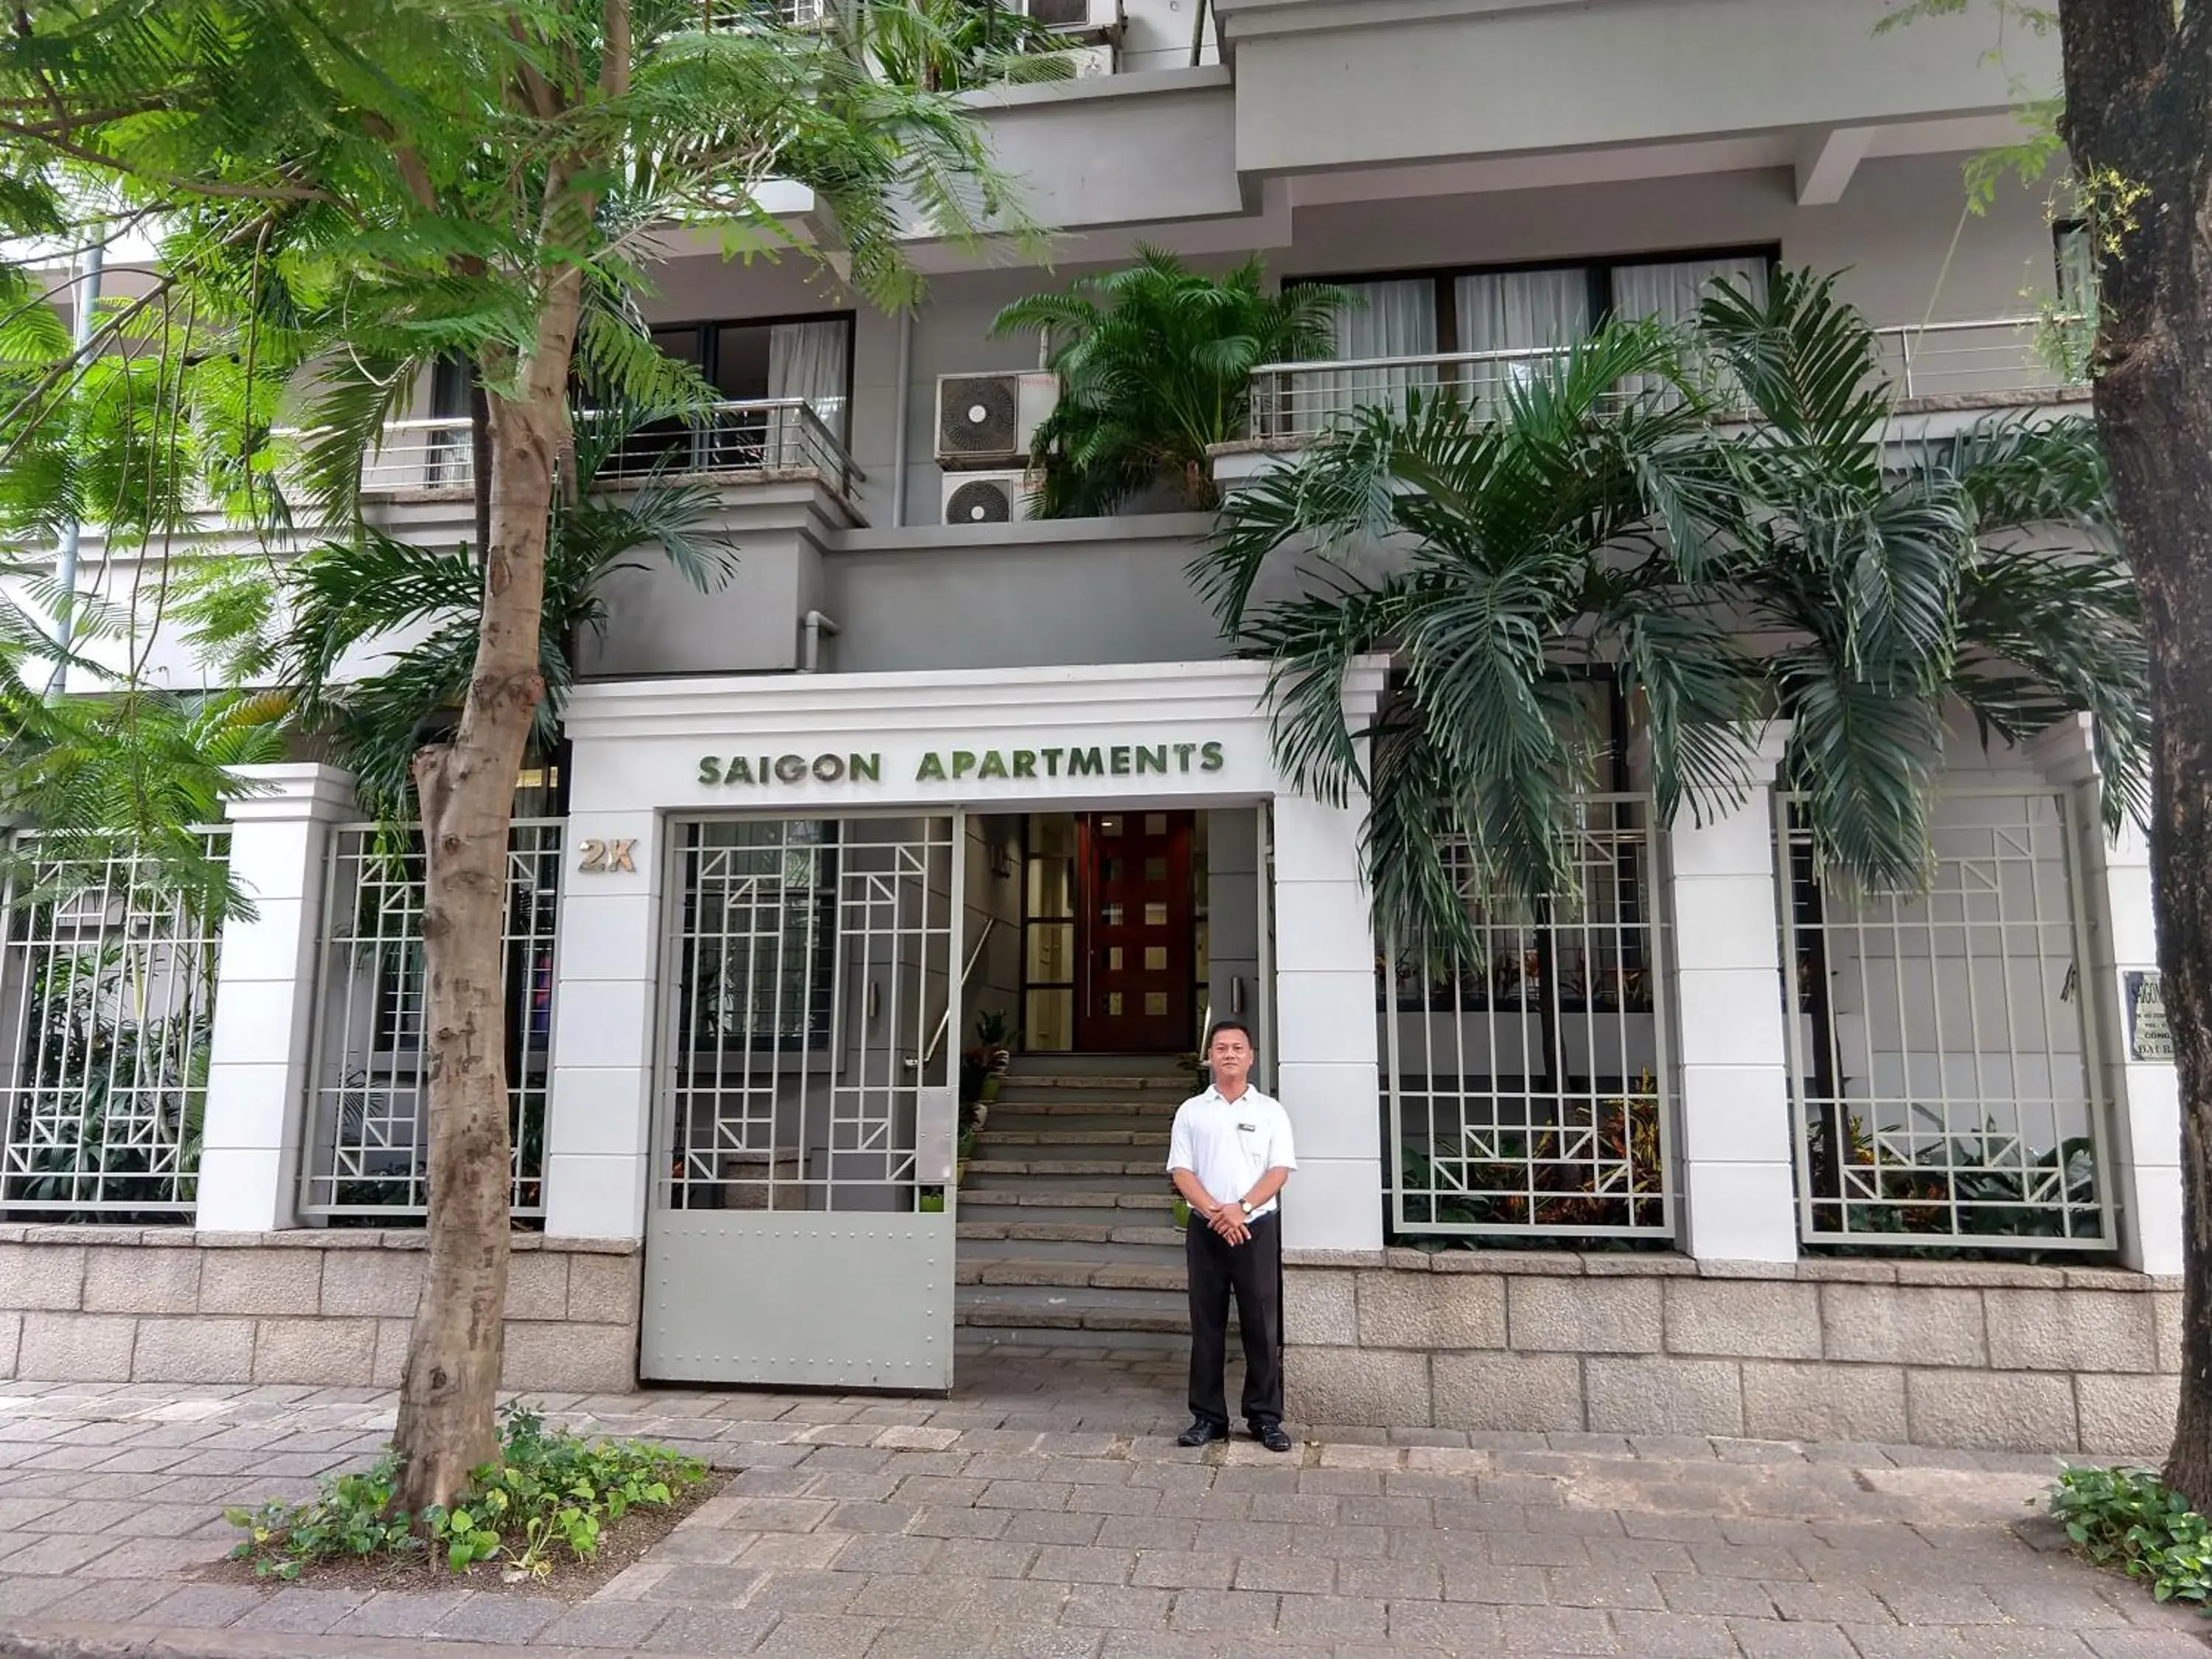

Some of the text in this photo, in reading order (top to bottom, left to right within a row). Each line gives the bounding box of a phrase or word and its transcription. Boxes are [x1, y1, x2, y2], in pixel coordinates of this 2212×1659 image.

[698, 741, 1225, 785] SAIGON APARTMENTS
[578, 839, 638, 872] 2K
